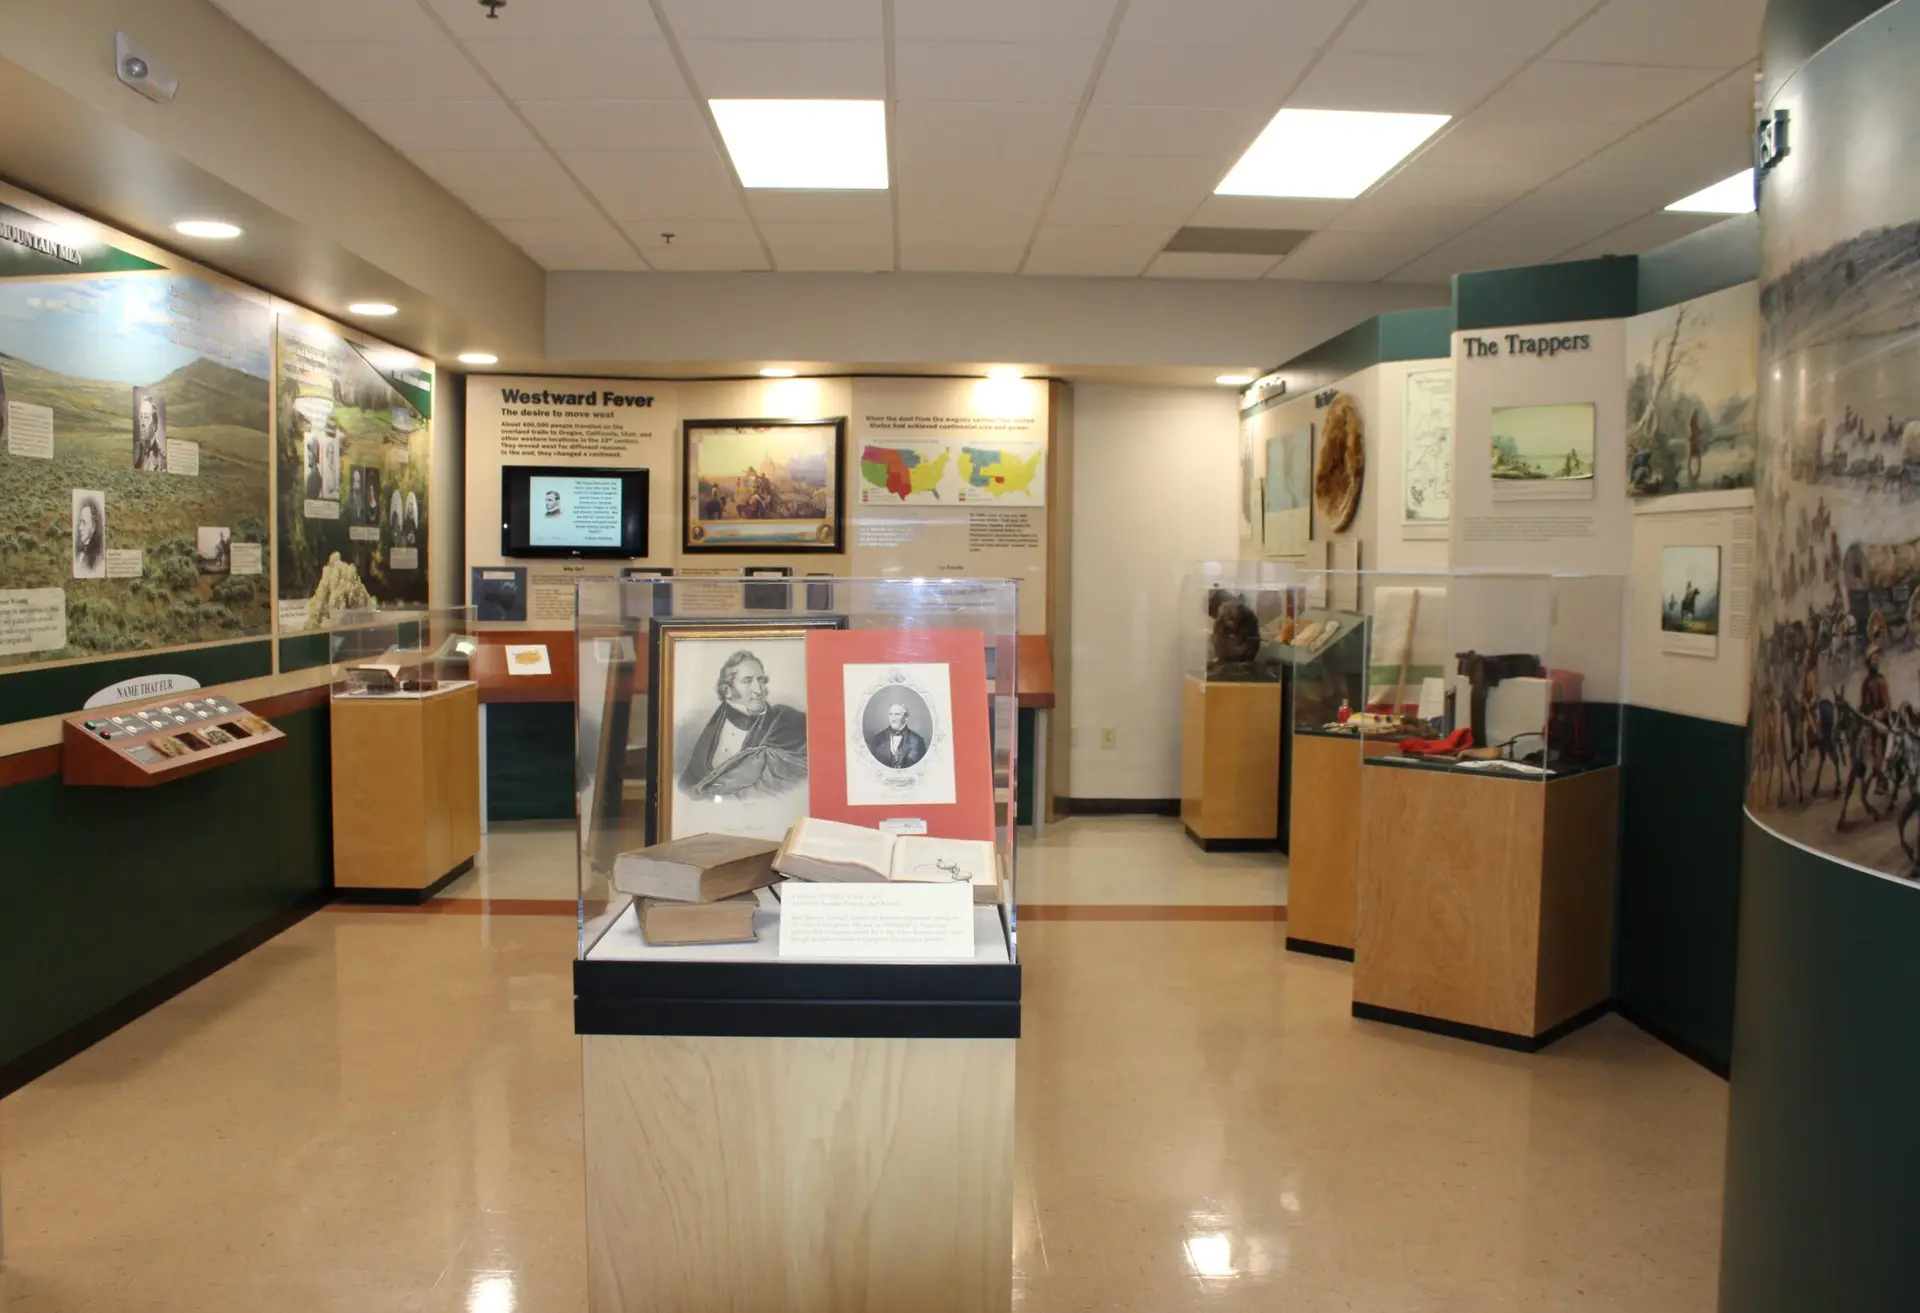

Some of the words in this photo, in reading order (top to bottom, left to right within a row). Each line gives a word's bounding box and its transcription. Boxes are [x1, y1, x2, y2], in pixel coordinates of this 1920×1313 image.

[59, 245, 82, 265] MEN
[1463, 337, 1499, 357] The
[1505, 333, 1590, 357] Trappers
[501, 388, 597, 405] Westward
[603, 391, 654, 407] Fever
[501, 408, 518, 416] The
[520, 408, 550, 417] desire
[117, 685, 139, 699] NAME
[140, 681, 159, 694] THAT
[160, 679, 173, 692] FUR
